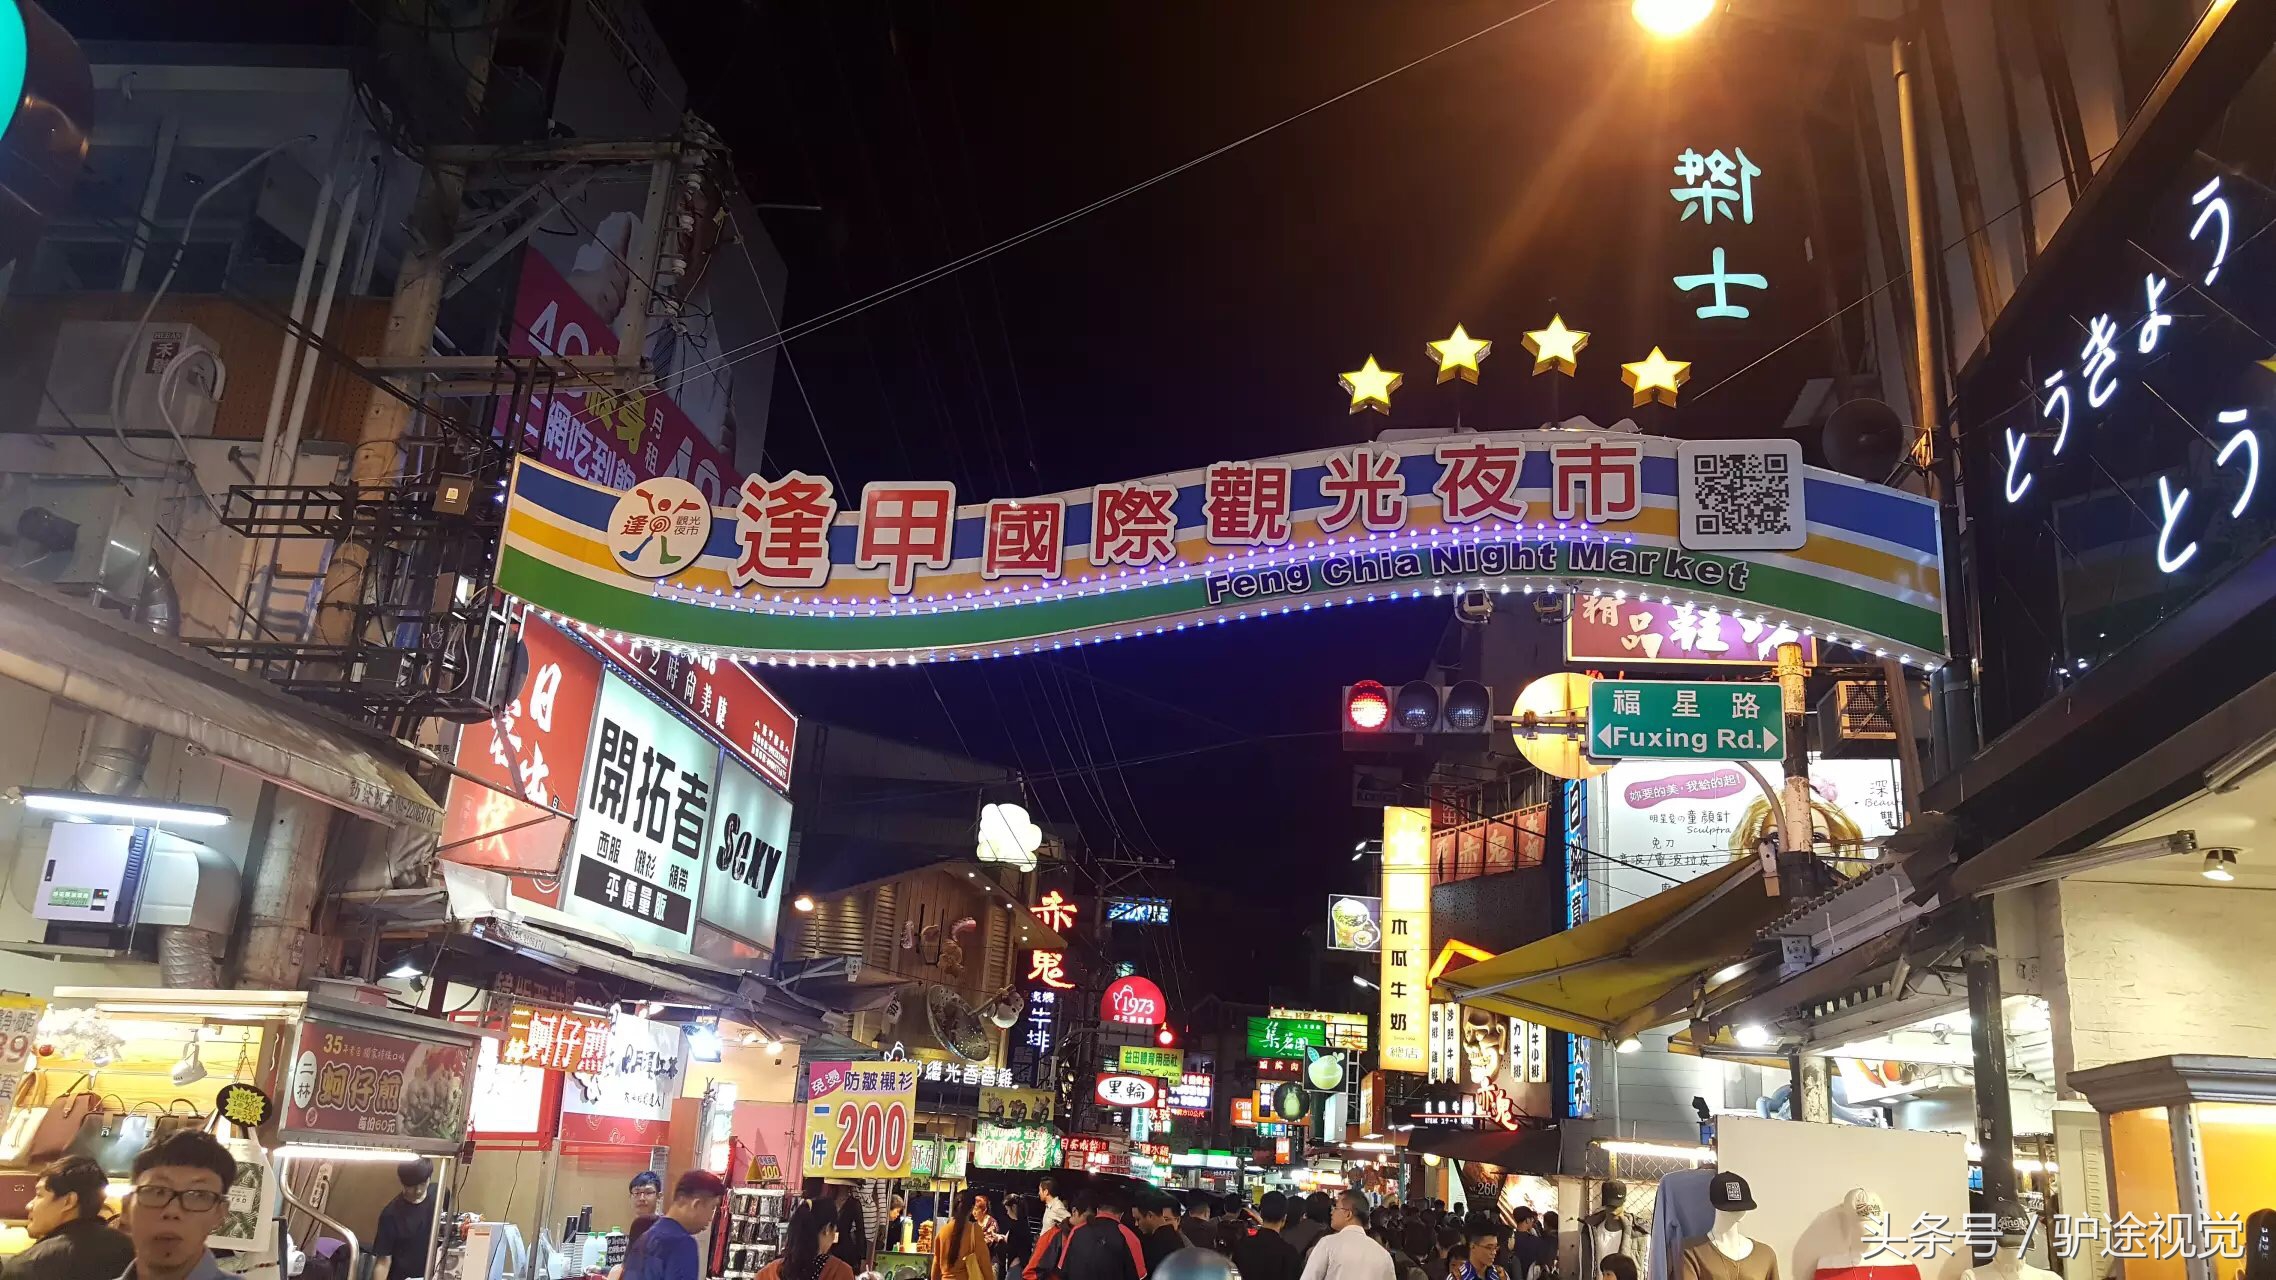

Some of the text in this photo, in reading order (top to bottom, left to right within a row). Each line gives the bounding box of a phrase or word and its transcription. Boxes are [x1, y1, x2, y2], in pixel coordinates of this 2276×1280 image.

[736, 443, 1642, 588] 逢甲國際觀光夜市
[1206, 539, 1750, 604] Feng Chia Night Market
[1612, 690, 1761, 720] 福星路
[1612, 726, 1763, 752] Fuxing Rd.
[588, 717, 710, 860] 開拓者
[597, 829, 622, 866] 西服
[668, 863, 691, 894] 領帶
[604, 873, 669, 923] 平價量販
[1028, 890, 1078, 990] 赤鬼
[1390, 917, 1408, 1031] 木瓜牛奶
[1026, 1007, 1052, 1054] 牛排
[1121, 997, 1155, 1015] 1973
[323, 1033, 343, 1054] 35
[526, 1010, 610, 1073] 蚵仔煎
[298, 1063, 314, 1099] 二林
[318, 1062, 403, 1113] 蚵仔煎
[843, 1069, 914, 1092] 防皺襯衫
[1108, 1080, 1146, 1100] 黑輪
[810, 1105, 828, 1167] 一件
[833, 1100, 907, 1171] 200
[761, 1165, 780, 1178] 100
[1477, 1182, 1497, 1196] 260
